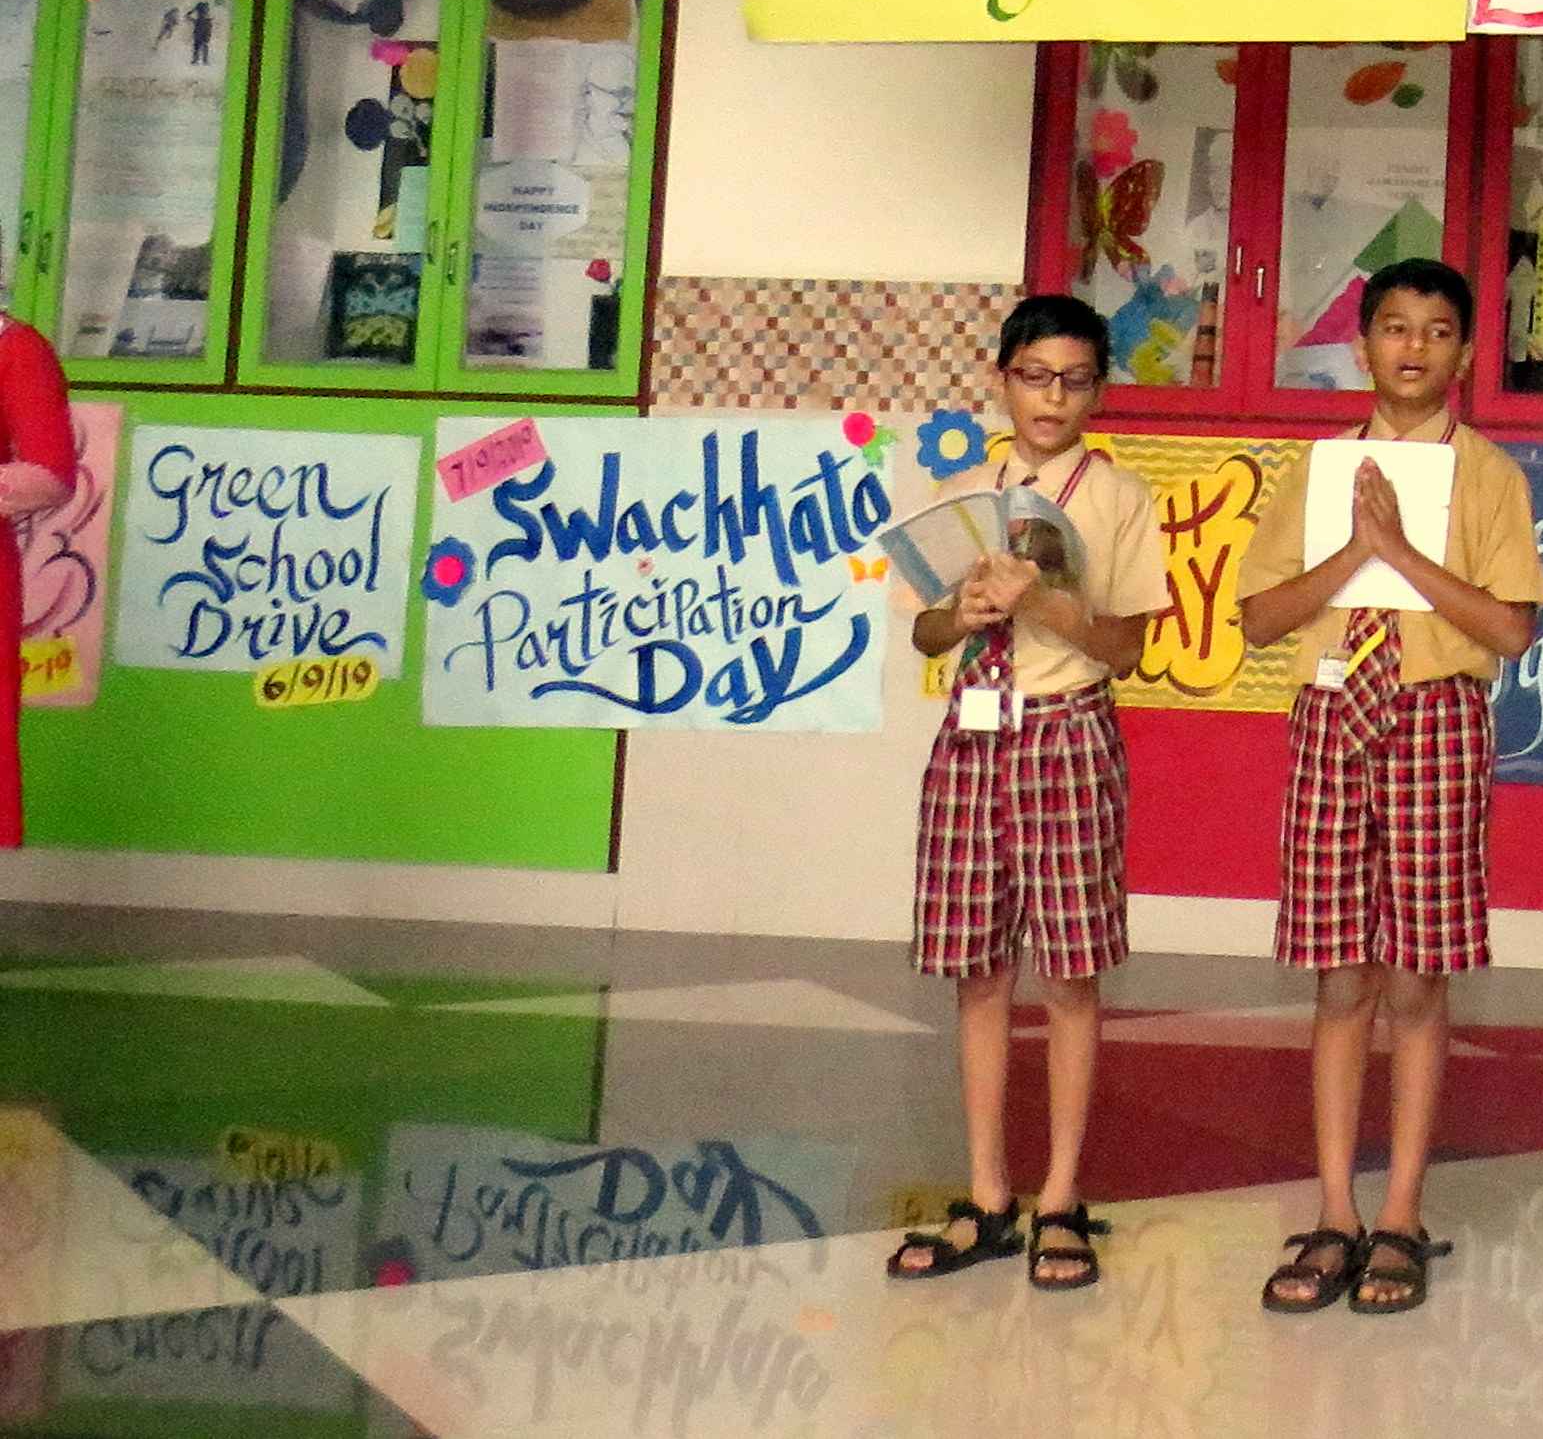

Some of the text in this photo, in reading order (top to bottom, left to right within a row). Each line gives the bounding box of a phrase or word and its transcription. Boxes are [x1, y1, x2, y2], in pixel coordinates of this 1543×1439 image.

[143, 444, 373, 544] Green
[158, 484, 392, 609] School
[487, 429, 892, 587] Swachhata
[170, 598, 388, 660] Drive
[444, 565, 843, 693] Participation
[1152, 544, 1230, 660] AY
[262, 660, 372, 701] 6/9/19
[530, 613, 870, 725] Day
